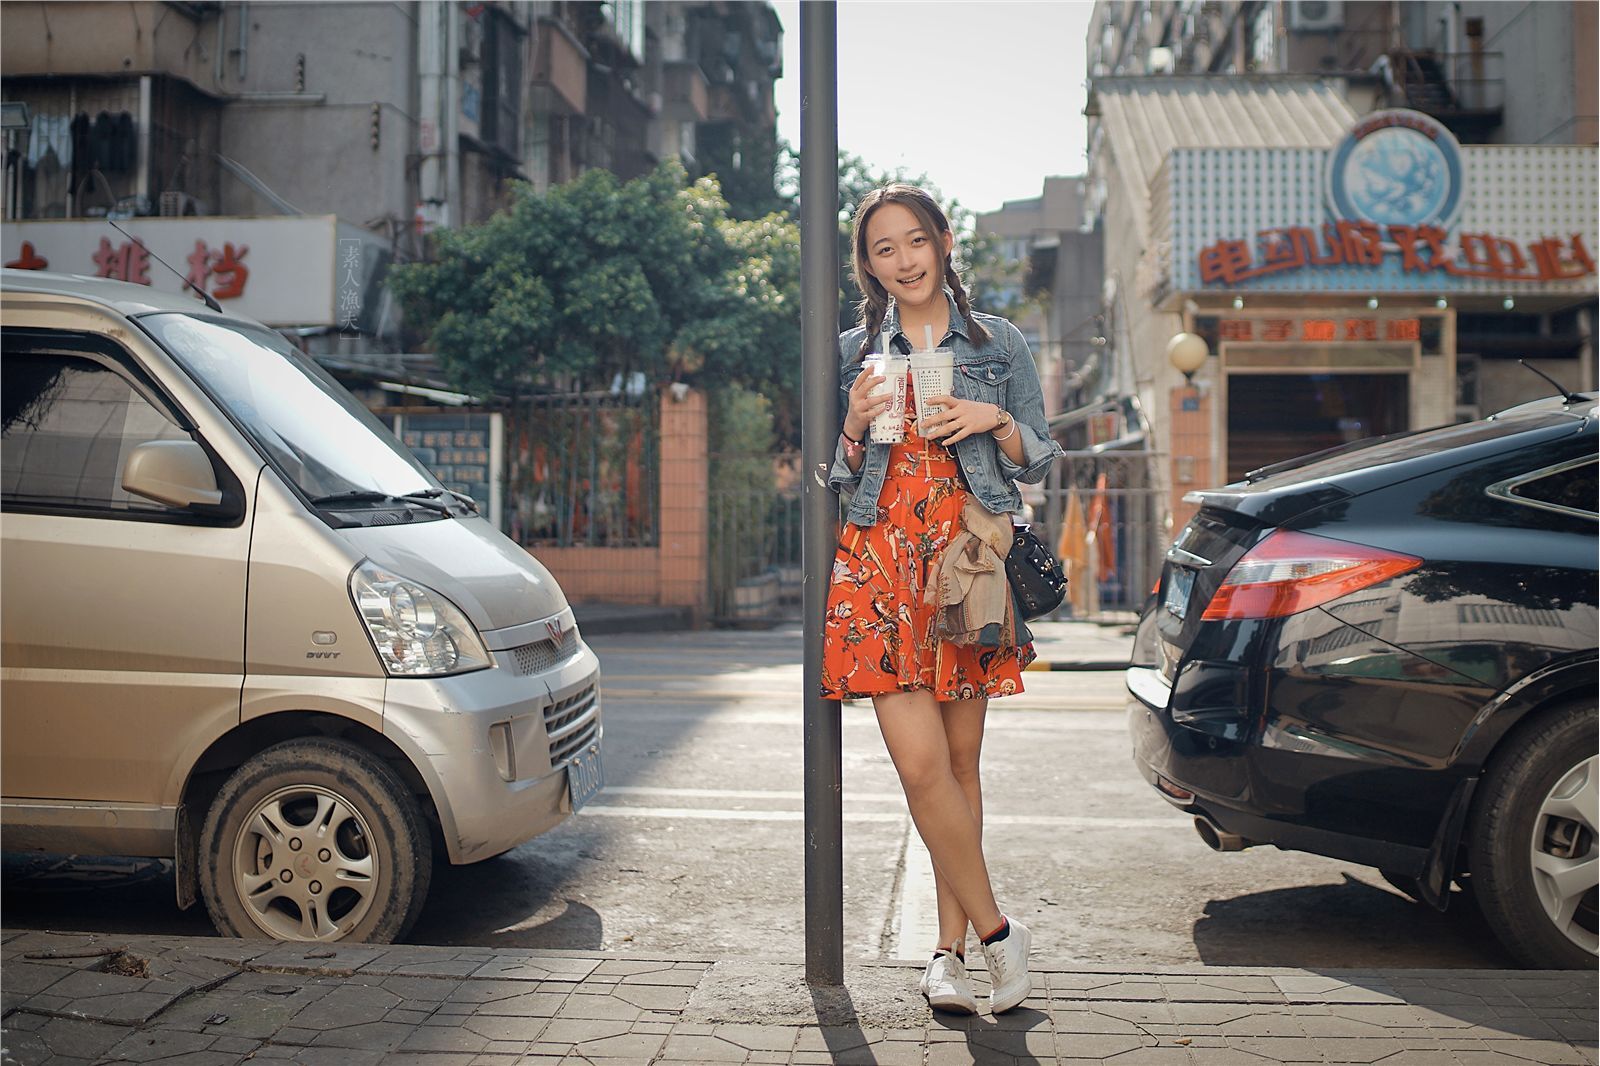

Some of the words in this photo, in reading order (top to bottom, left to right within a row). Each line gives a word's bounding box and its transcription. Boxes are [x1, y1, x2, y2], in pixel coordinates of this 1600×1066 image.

[1199, 219, 1597, 285] 电动游戏中心
